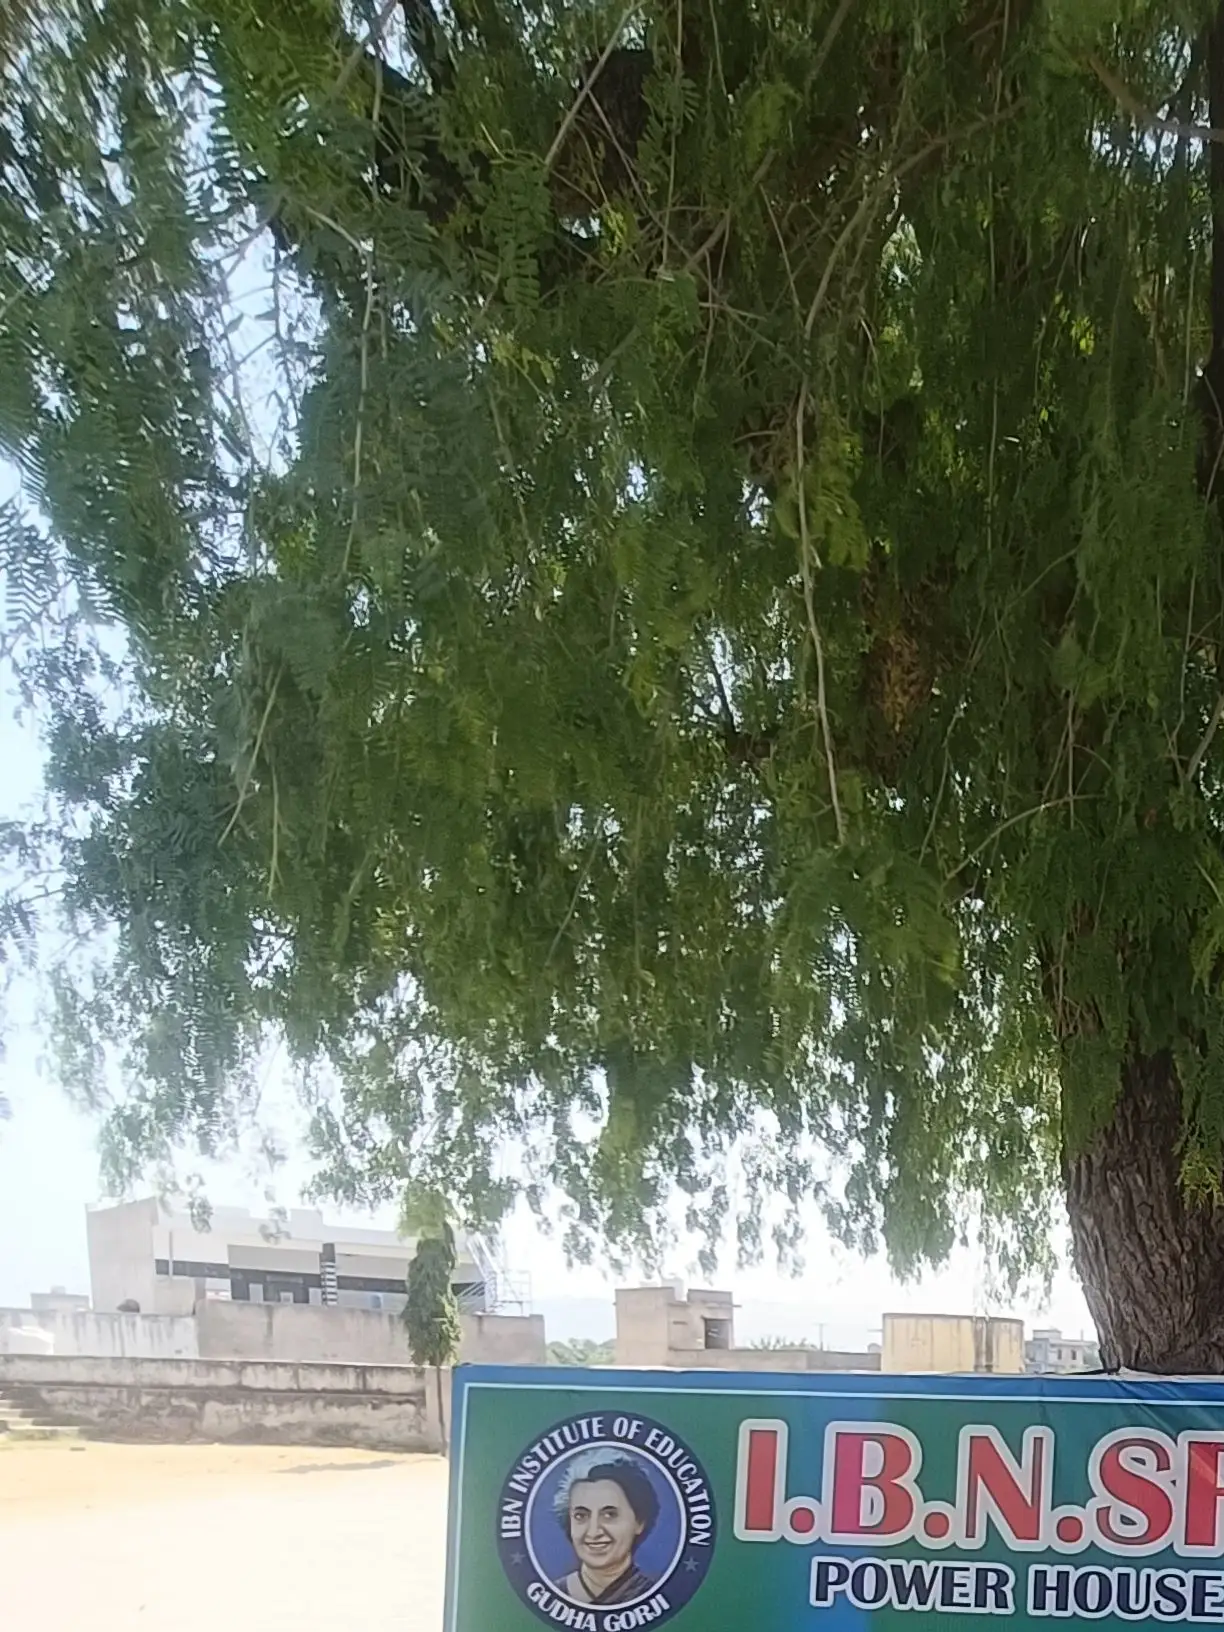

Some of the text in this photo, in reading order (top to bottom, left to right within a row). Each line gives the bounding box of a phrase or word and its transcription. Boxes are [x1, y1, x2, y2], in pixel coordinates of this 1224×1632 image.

[501, 1416, 713, 1548] IBN INSTITUTE OF EDUCATION
[526, 1582, 670, 1632] GUDHA GORJI
[810, 1556, 1018, 1616] POWER
